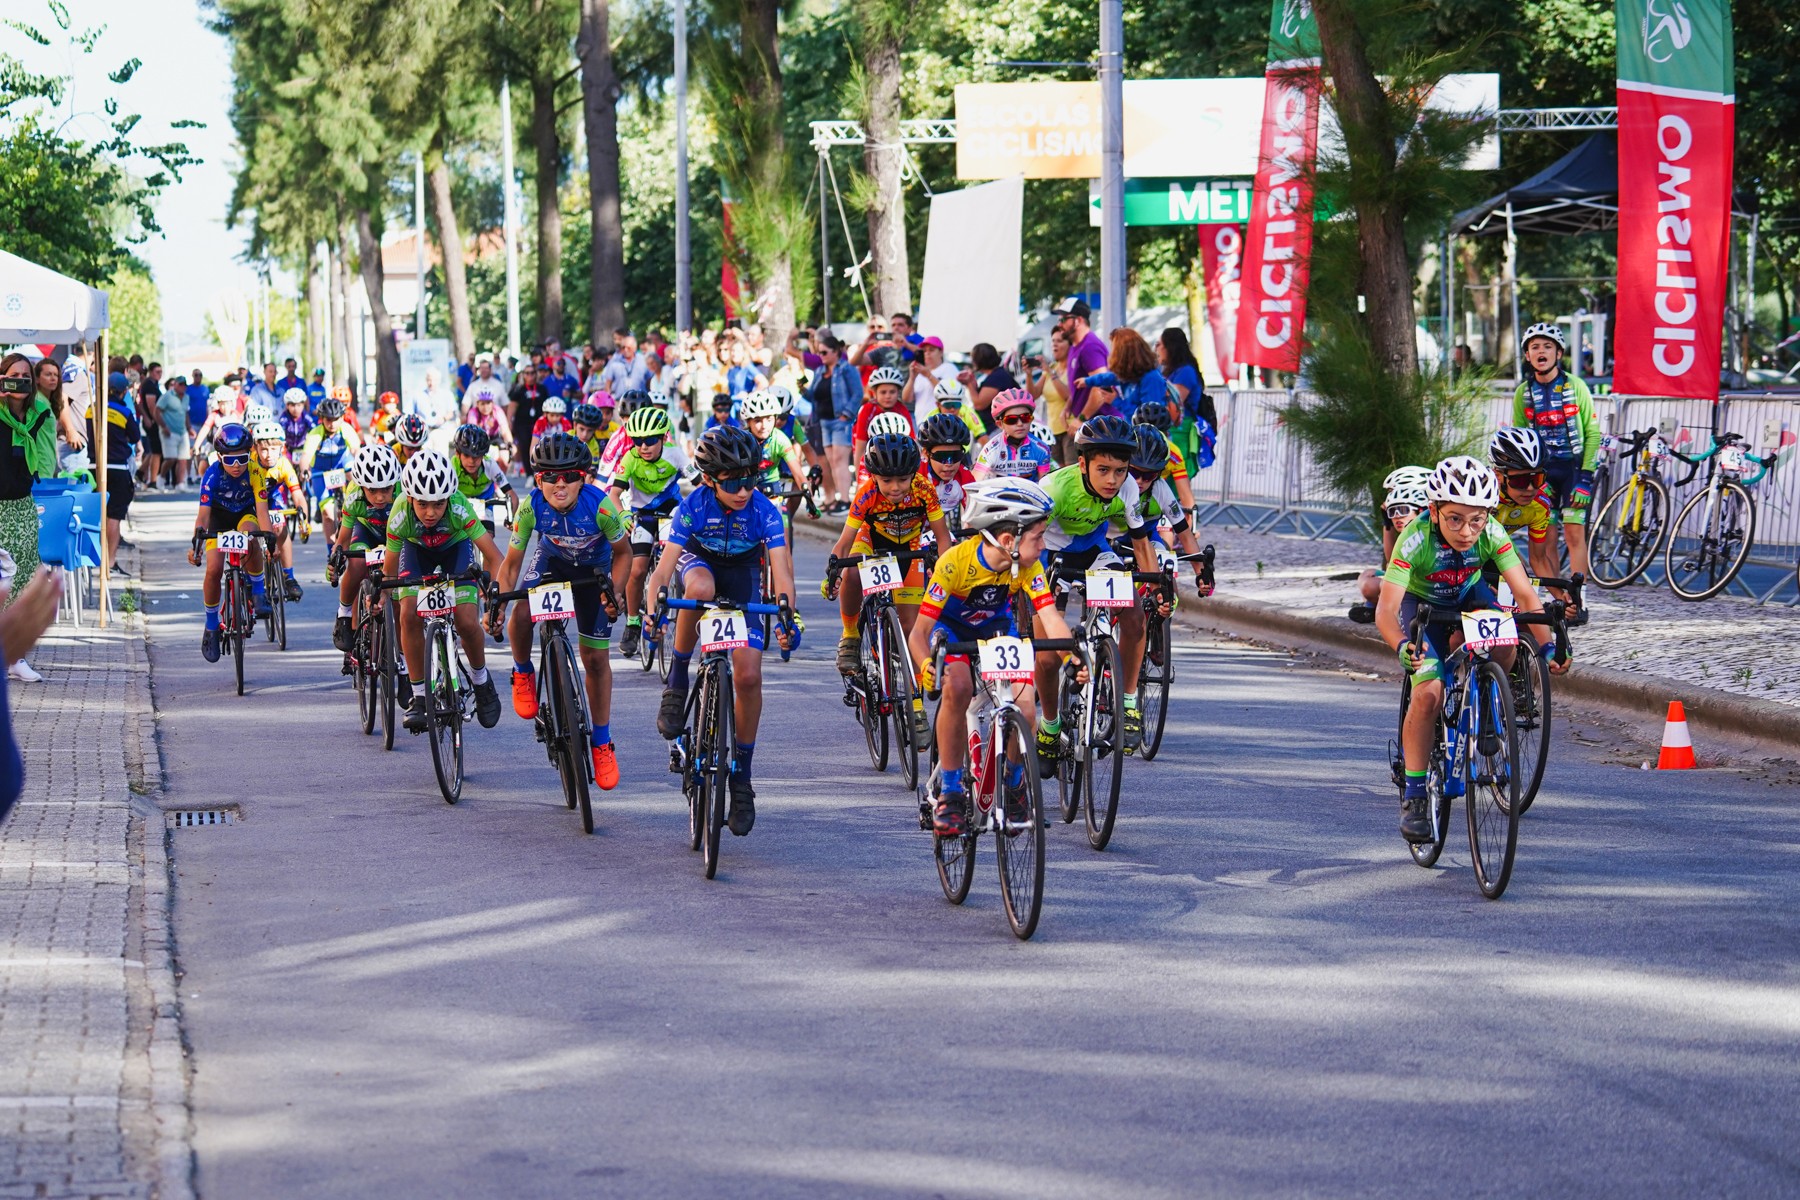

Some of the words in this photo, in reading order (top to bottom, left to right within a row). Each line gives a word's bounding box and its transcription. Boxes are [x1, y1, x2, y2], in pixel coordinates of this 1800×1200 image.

[963, 102, 1090, 129] ESCOLAS
[222, 534, 244, 549] 213
[374, 549, 386, 560] 7
[870, 564, 891, 586] 38
[866, 583, 901, 594] FIDELIDADE
[1105, 577, 1114, 599] 1
[427, 590, 446, 610] 68
[541, 591, 563, 613] 42
[535, 612, 572, 622] FIDELIDADE
[712, 617, 736, 642] 24
[1477, 617, 1501, 640] 67
[705, 641, 746, 652] FIDELIDADE
[995, 645, 1020, 670] 33
[986, 671, 1031, 680] FIDELIDADE
